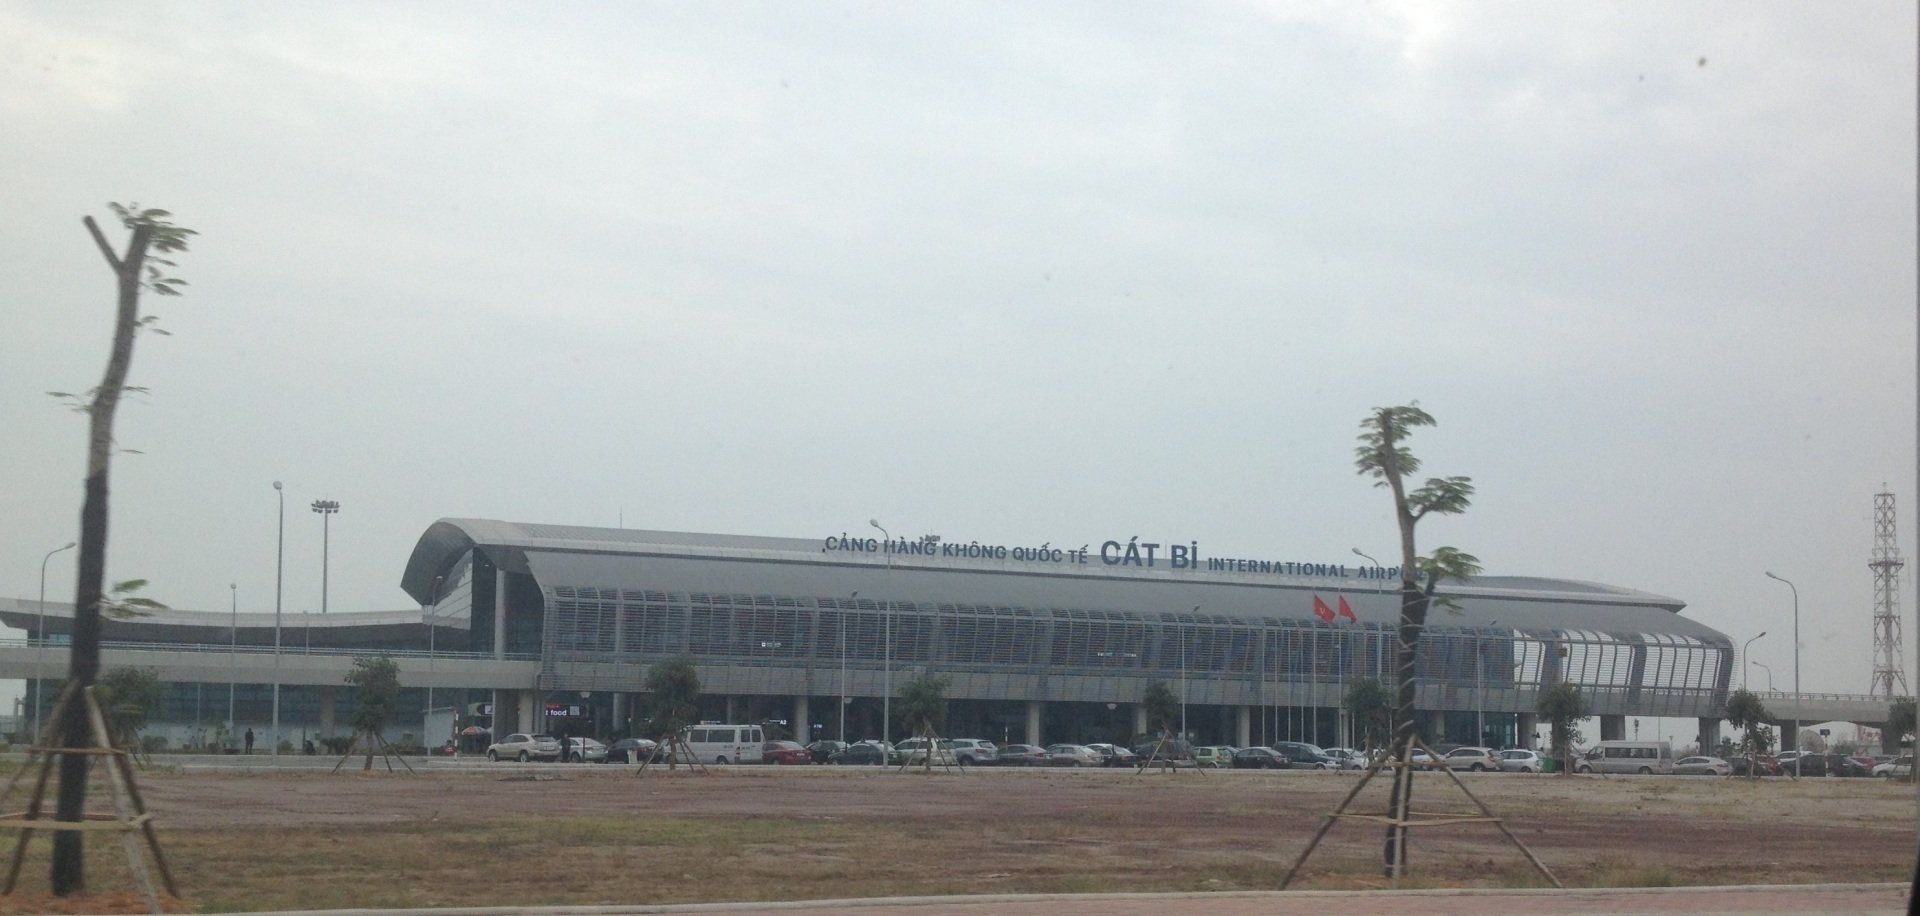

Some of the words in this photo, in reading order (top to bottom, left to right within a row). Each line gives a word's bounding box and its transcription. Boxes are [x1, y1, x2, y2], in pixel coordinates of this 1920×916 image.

[825, 532, 878, 553] CẢNG
[884, 536, 937, 556] HÀNG
[943, 540, 1007, 560] KHÔNG
[1012, 542, 1063, 563] QUỐC
[1068, 544, 1089, 564] TẾ
[1101, 535, 1160, 567] CÁT
[1208, 557, 1349, 578] INTERNATIONAL
[1358, 565, 1437, 582] AIRP
